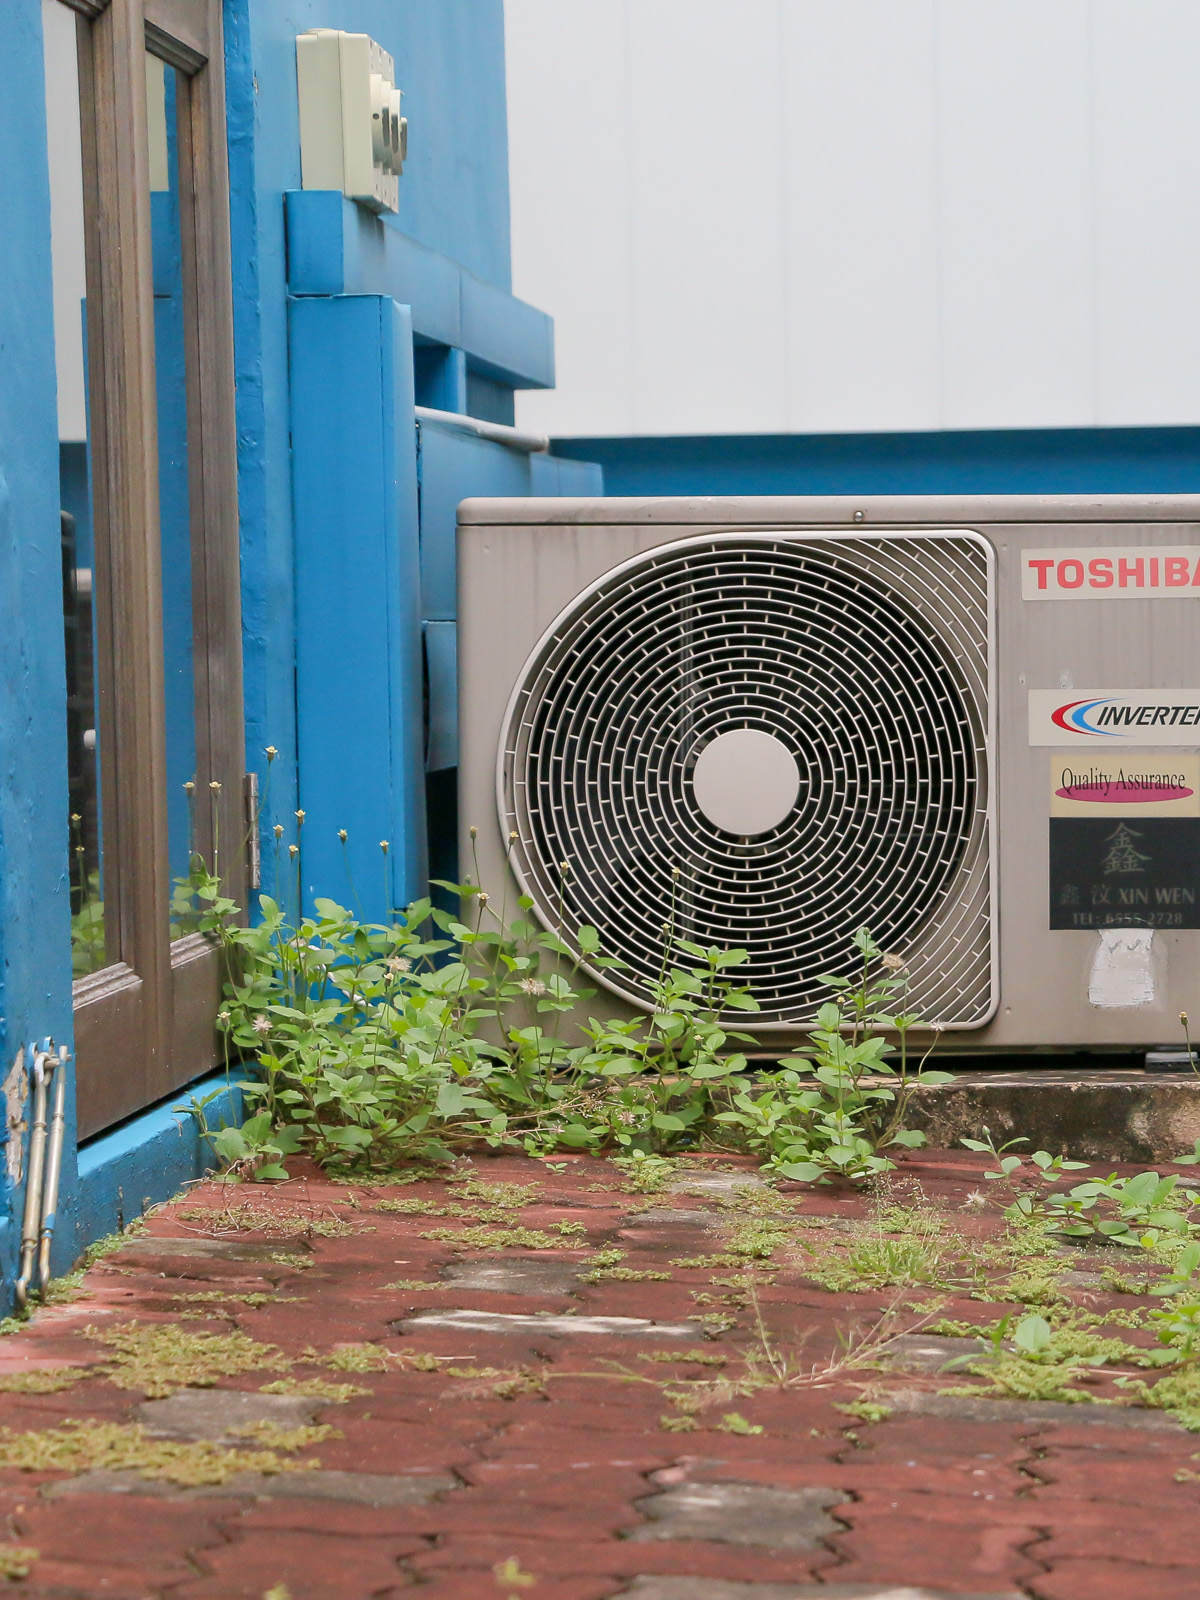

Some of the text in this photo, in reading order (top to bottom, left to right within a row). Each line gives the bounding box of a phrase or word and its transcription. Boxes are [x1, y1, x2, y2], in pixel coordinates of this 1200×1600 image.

[1061, 768, 1186, 796] Quality Assurance
[1102, 822, 1152, 875] 鑫
[1119, 888, 1148, 904] XIN
[1155, 888, 1195, 904] WEN
[1072, 912, 1100, 925] TEL:
[1148, 912, 1184, 925] 2728
